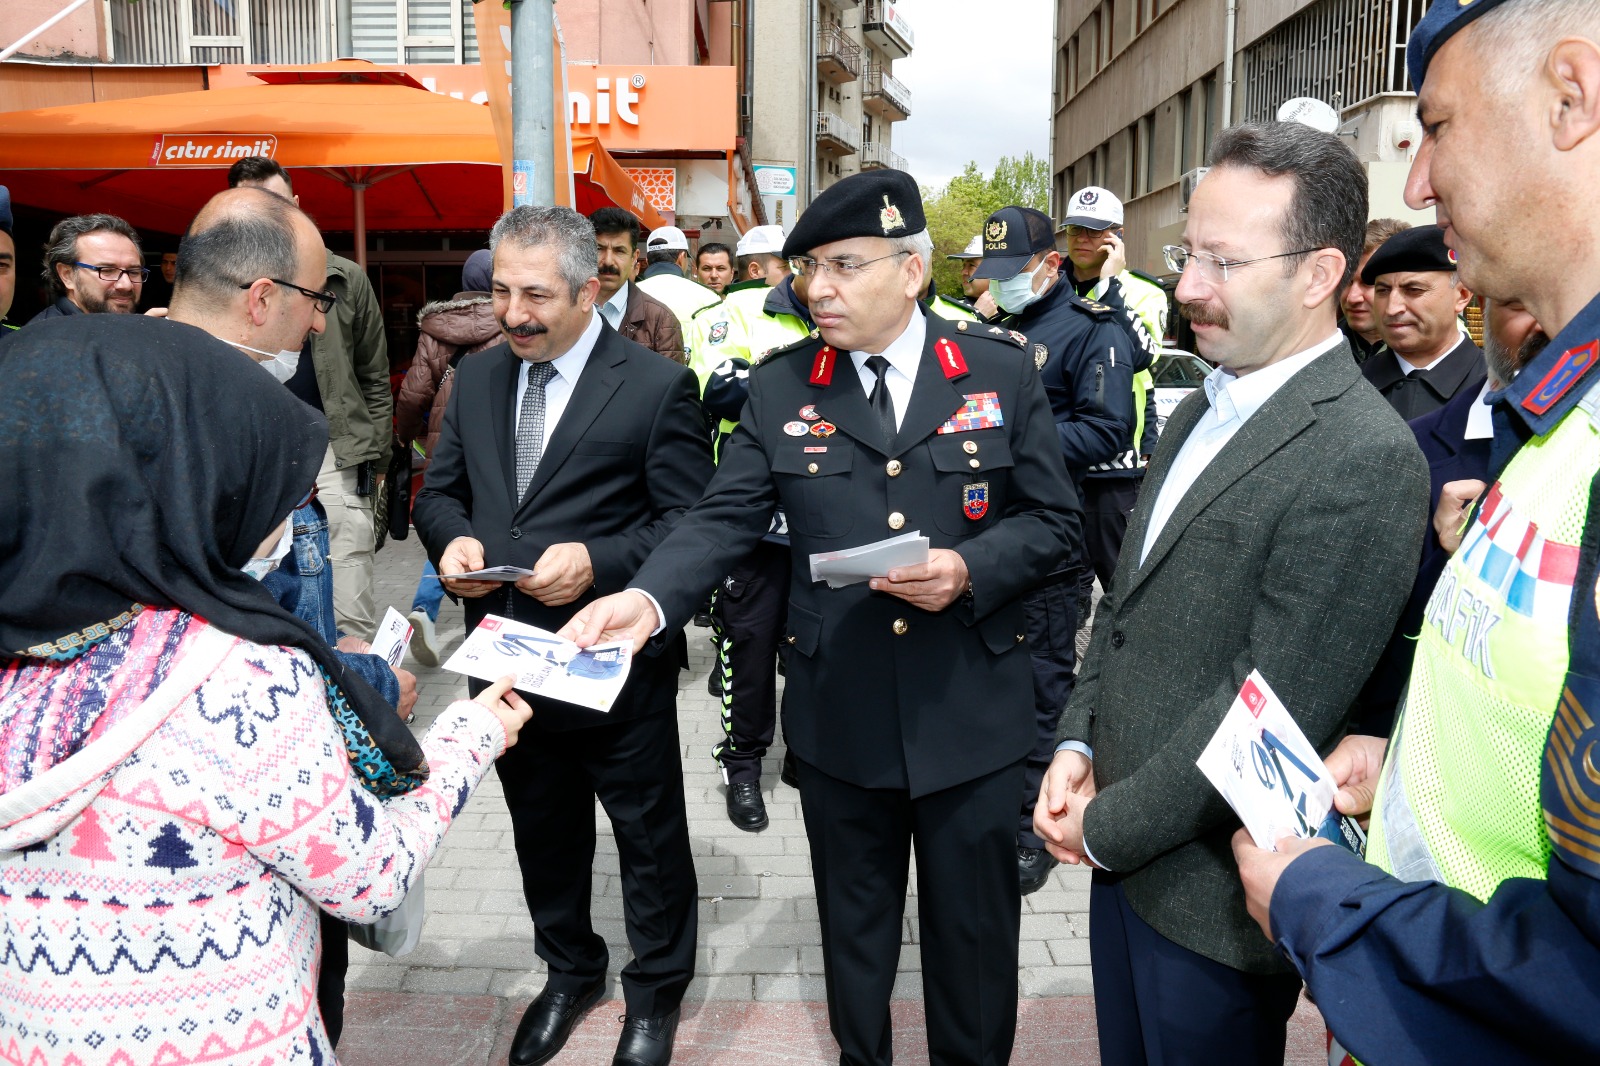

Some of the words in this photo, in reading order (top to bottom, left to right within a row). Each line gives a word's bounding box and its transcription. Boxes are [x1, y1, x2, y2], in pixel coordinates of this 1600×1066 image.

[165, 141, 213, 160] çıtır
[213, 141, 271, 158] simit
[465, 653, 479, 661] 5
